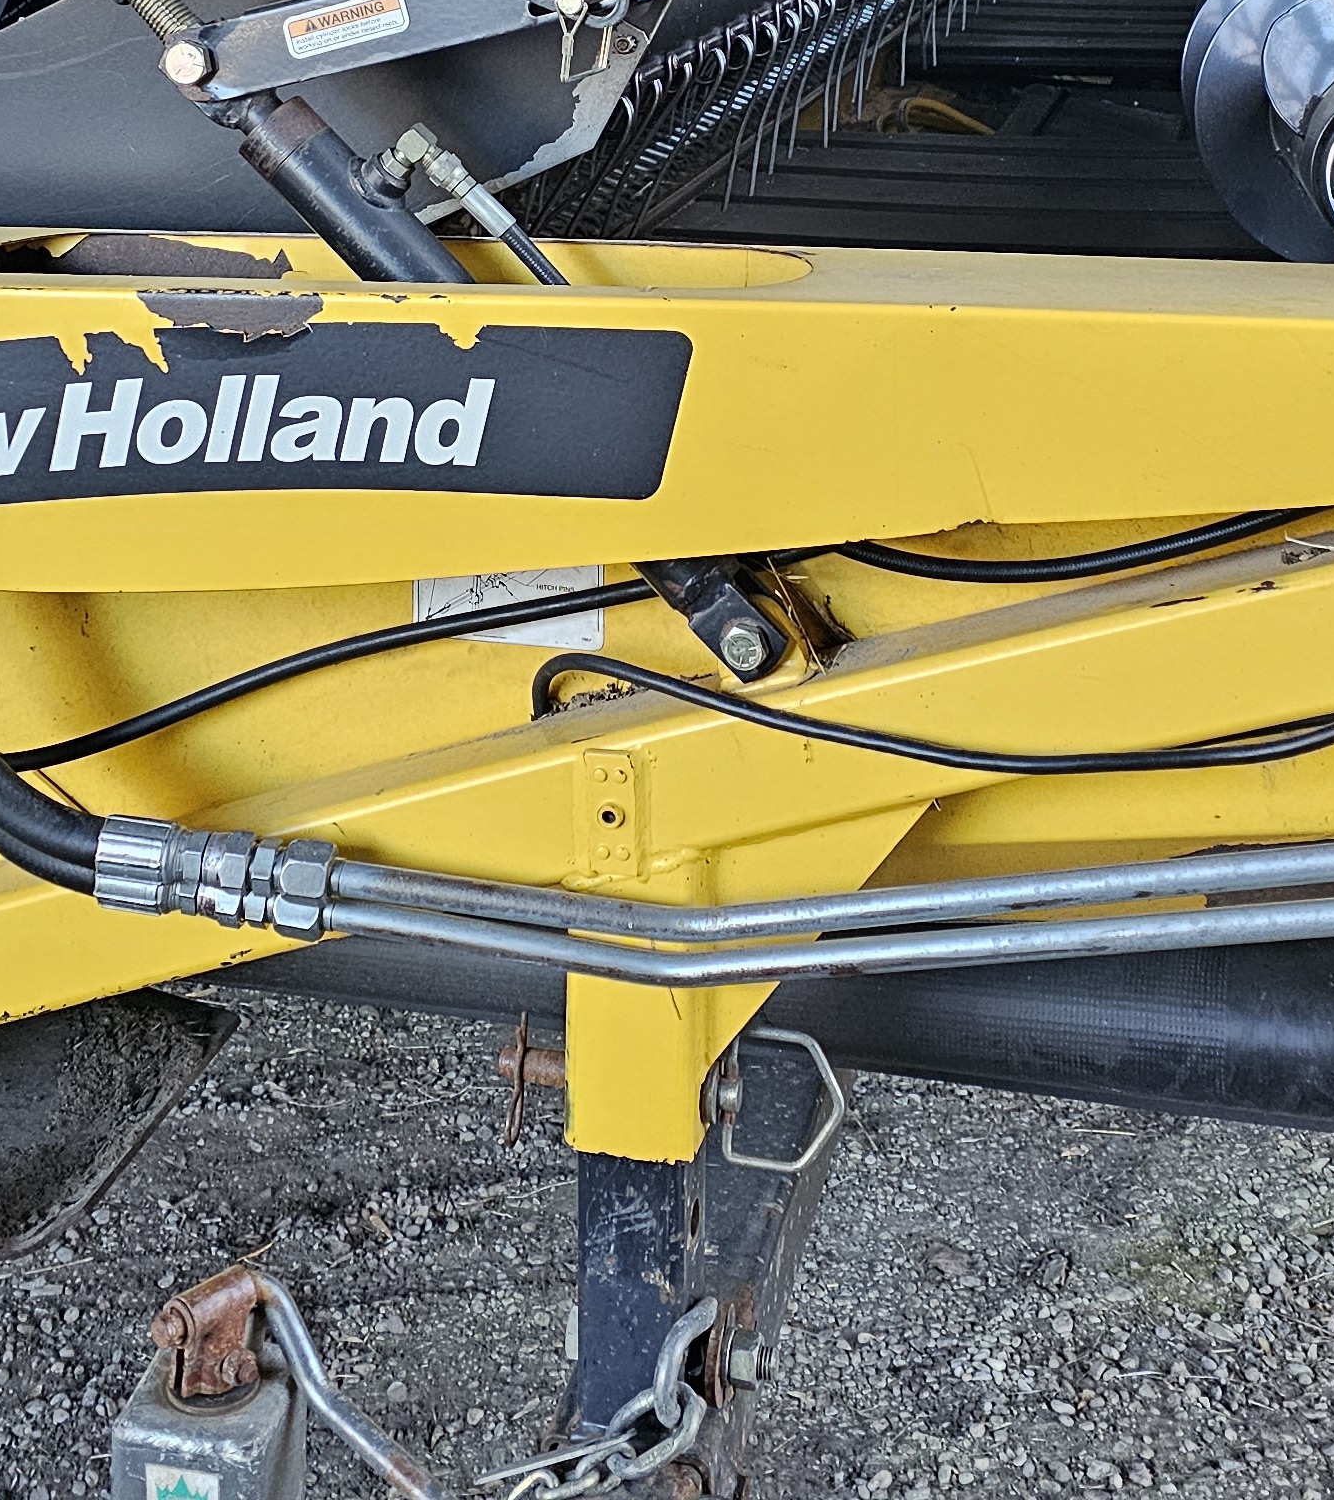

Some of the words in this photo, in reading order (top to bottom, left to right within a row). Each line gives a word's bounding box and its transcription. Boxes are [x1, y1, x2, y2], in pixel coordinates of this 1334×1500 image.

[317, 1, 385, 27] WARNING
[296, 34, 315, 45] Install
[316, 28, 341, 40] cylinder
[342, 23, 359, 33] locks
[360, 17, 381, 28] before
[297, 41, 323, 52] working
[341, 30, 360, 40] under
[50, 374, 497, 472] Holland
[536, 583, 557, 592] HITCH
